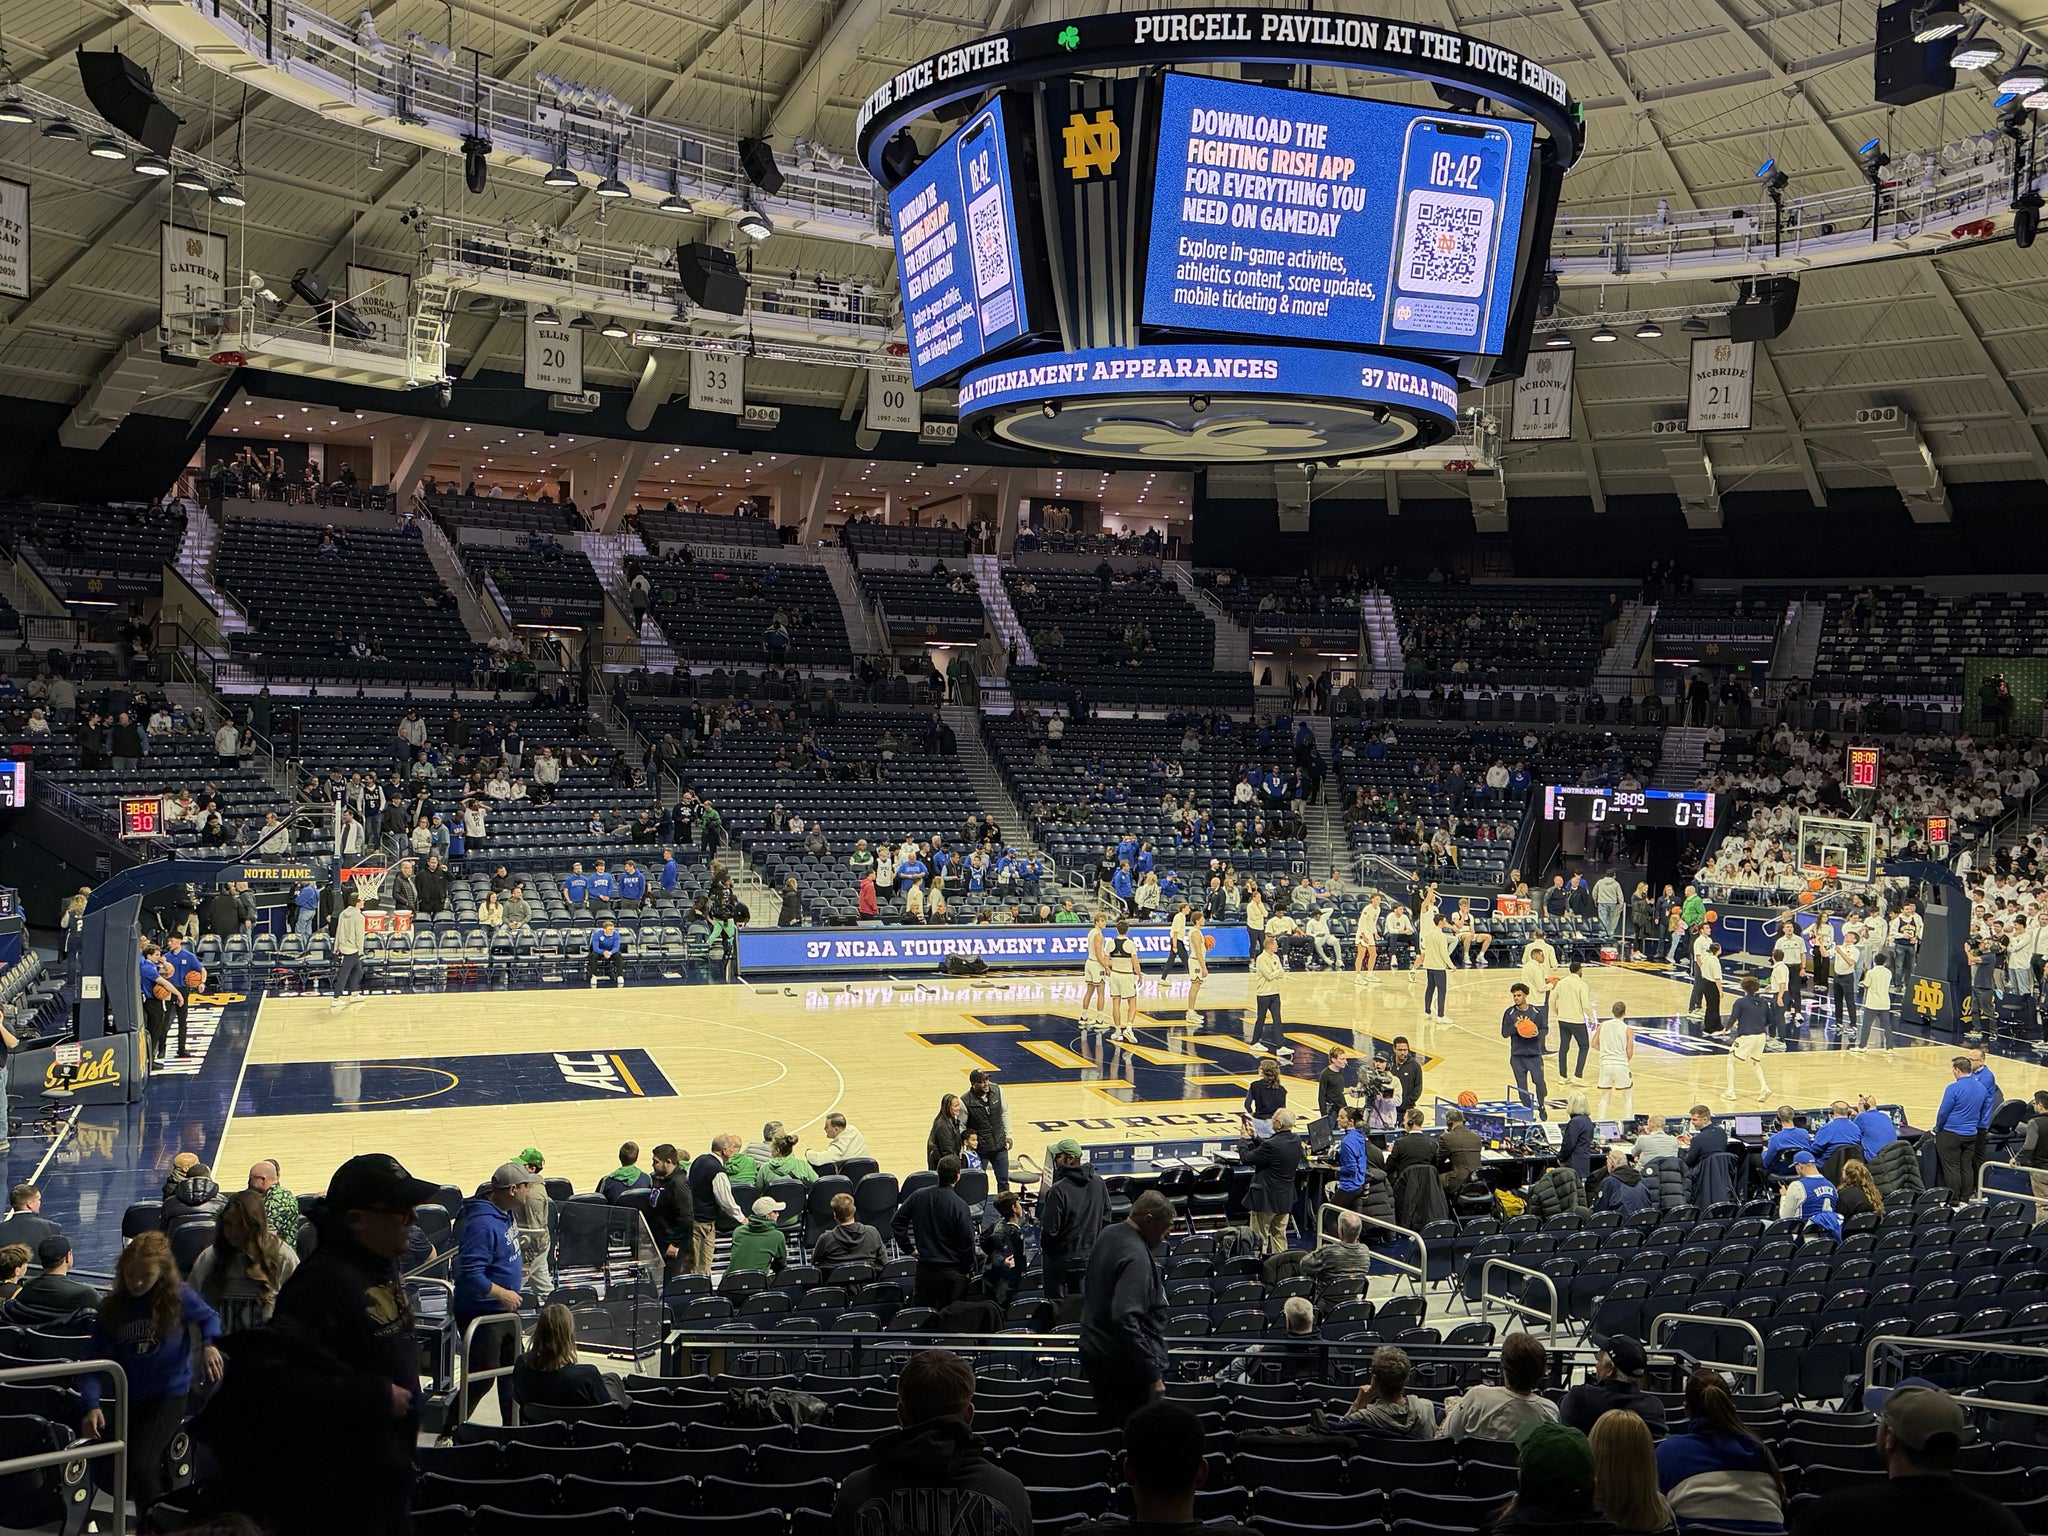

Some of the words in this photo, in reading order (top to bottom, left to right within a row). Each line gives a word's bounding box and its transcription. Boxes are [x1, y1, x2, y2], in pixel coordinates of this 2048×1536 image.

[1134, 13, 1252, 44] PURCELL
[1261, 14, 1379, 49] PAVILION
[1384, 25, 1415, 54] AT
[1420, 29, 1462, 64] THE
[1465, 40, 1518, 81] JOYCE
[1520, 59, 1567, 106] CENTER
[874, 80, 892, 115] THE
[894, 60, 933, 101] JOYCE
[937, 37, 1009, 80] CENTER
[1191, 108, 1292, 144] DOWNLOAD
[1296, 122, 1328, 149] THE
[1187, 138, 1269, 172] FIGHTING
[1271, 148, 1318, 178] IRISH
[1319, 155, 1355, 182] APP
[969, 150, 991, 194] 18:42
[1430, 152, 1481, 190] 18:42
[1185, 168, 1221, 195] FOR
[1223, 172, 1328, 208] EVERYTHING
[1332, 184, 1367, 212] YOU
[1182, 197, 1228, 226] NEED
[1232, 203, 1258, 229] ON
[1260, 207, 1342, 238] GAMEDAY
[1179, 236, 1227, 263] Explore
[1230, 241, 1285, 266] in-game
[1287, 249, 1347, 275] activities,
[170, 263, 219, 283] GAITHER
[1176, 262, 1231, 285] athletics
[1233, 269, 1285, 292] content,
[1288, 276, 1321, 293] score
[1323, 277, 1376, 301] updates,
[1174, 286, 1219, 307] mobile
[1222, 290, 1277, 315] ticketing
[1280, 294, 1289, 314] &
[1292, 299, 1330, 317] more!
[538, 330, 570, 342] ELLIS
[542, 348, 565, 368] 20
[704, 353, 730, 364] IVEY
[707, 370, 727, 390] 33
[881, 374, 910, 384] RILEY
[976, 362, 1088, 398] TOURNAMENT
[1092, 358, 1278, 380] APPEARANCES
[1361, 367, 1384, 388] 37
[1386, 371, 1429, 397] NCAA
[1696, 368, 1748, 381] McBRIDE
[1519, 379, 1567, 393] ACHONWA
[1708, 386, 1730, 405] 21
[884, 390, 904, 408] 00
[1532, 397, 1550, 415] 11
[1722, 412, 1739, 420] 2014
[729, 548, 758, 561] DAME
[1852, 751, 1876, 763] 38:08
[1854, 763, 1873, 784] 30
[1561, 786, 1584, 795] NOTRE
[1613, 791, 1645, 806] 38:09
[6, 794, 13, 807] 0
[126, 802, 158, 814] 38:08
[1592, 798, 1607, 821] 0
[132, 815, 154, 831] 30
[1559, 811, 1565, 820] 0
[1675, 803, 1690, 826] 0
[1697, 818, 1704, 827] 0
[1931, 829, 1943, 840] 30
[243, 868, 278, 879] NOTRE
[281, 869, 311, 879] DAME
[807, 941, 831, 958] 37
[835, 940, 897, 957] NCAA
[901, 938, 1046, 956] TOURNAMENT
[1188, 1126, 1238, 1136] TH
